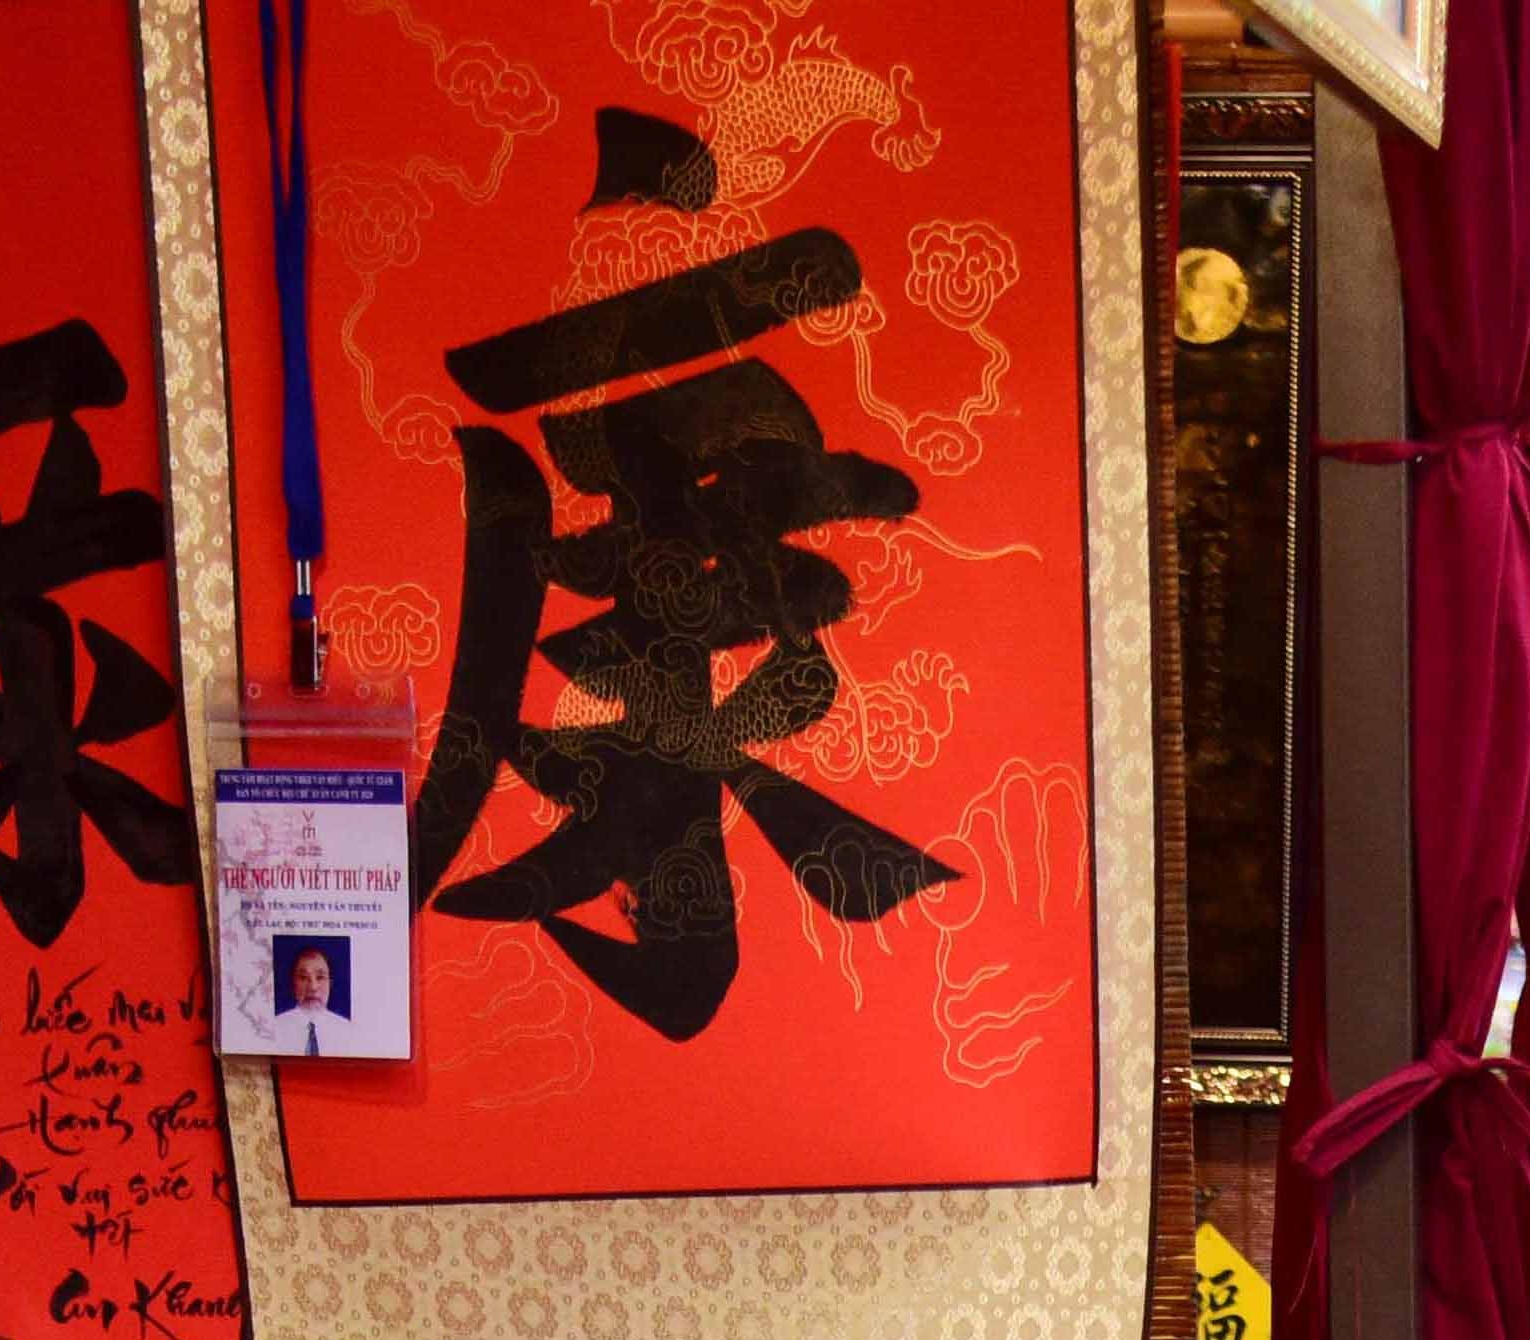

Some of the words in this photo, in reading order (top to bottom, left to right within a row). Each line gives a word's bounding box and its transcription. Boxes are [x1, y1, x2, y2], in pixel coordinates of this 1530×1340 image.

[223, 861, 247, 889] THẺ
[252, 861, 295, 890] NGƯỜI
[300, 864, 332, 890] VIẾT
[334, 866, 363, 891] THƯ
[366, 862, 401, 892] PHÁP
